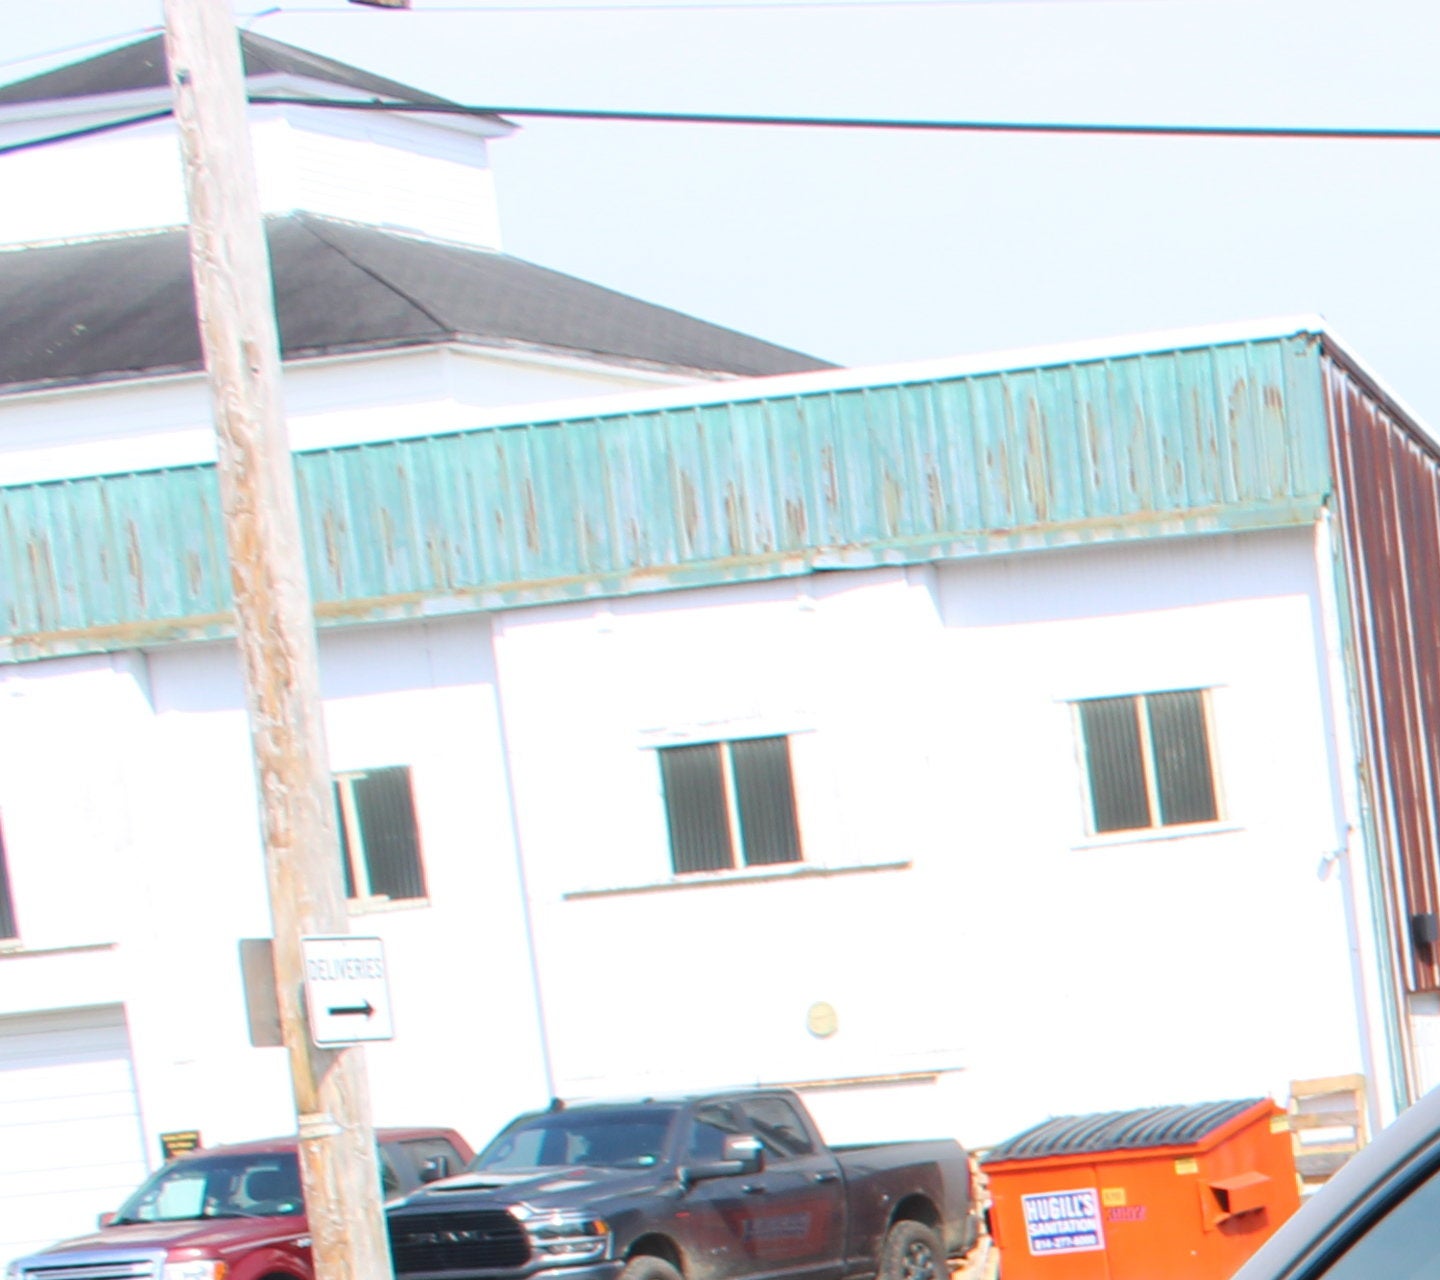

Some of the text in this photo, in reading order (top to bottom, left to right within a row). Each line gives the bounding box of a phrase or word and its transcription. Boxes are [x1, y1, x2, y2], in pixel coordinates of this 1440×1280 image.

[307, 957, 385, 981] DELIVERIES
[1025, 1195, 1094, 1221] HUGILL'S
[1028, 1220, 1096, 1236] SANITATION
